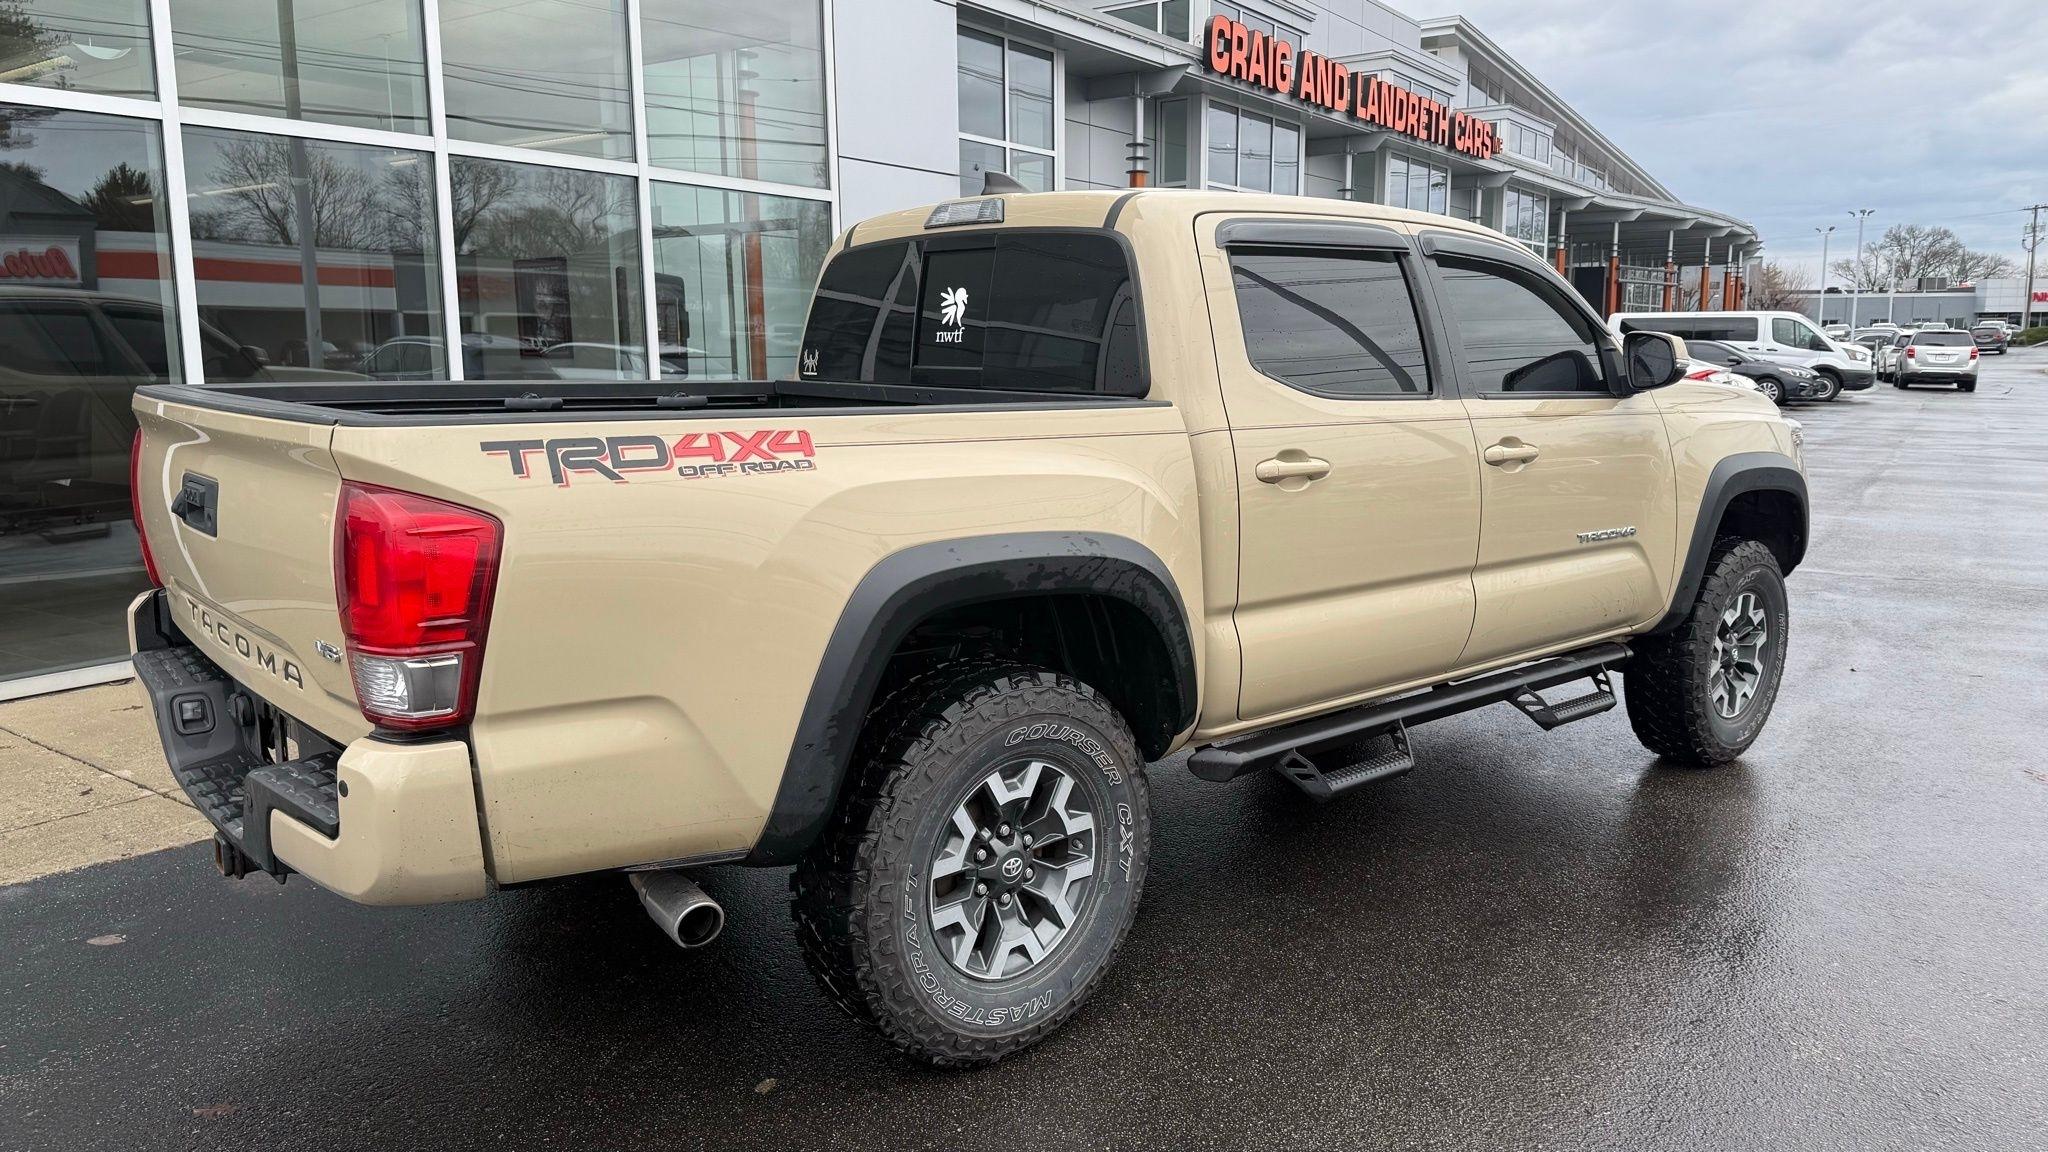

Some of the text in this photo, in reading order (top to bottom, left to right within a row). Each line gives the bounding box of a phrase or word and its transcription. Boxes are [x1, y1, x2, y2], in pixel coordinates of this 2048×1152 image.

[1207, 14, 1293, 94] CRAIG
[1299, 48, 1349, 113] AND
[1355, 71, 1449, 147] LANDRETH
[1453, 111, 1492, 160] CARS
[2031, 290, 2048, 303] NI
[935, 326, 966, 343] nwtf
[480, 429, 816, 488] TRD 4X4
[677, 459, 817, 480] OFF ROAD
[1576, 526, 1637, 544] TACOMA
[187, 597, 304, 690] TACOMA
[1004, 723, 1135, 883] COURSER CXT
[902, 862, 1054, 1026] MASTERCRAFT
